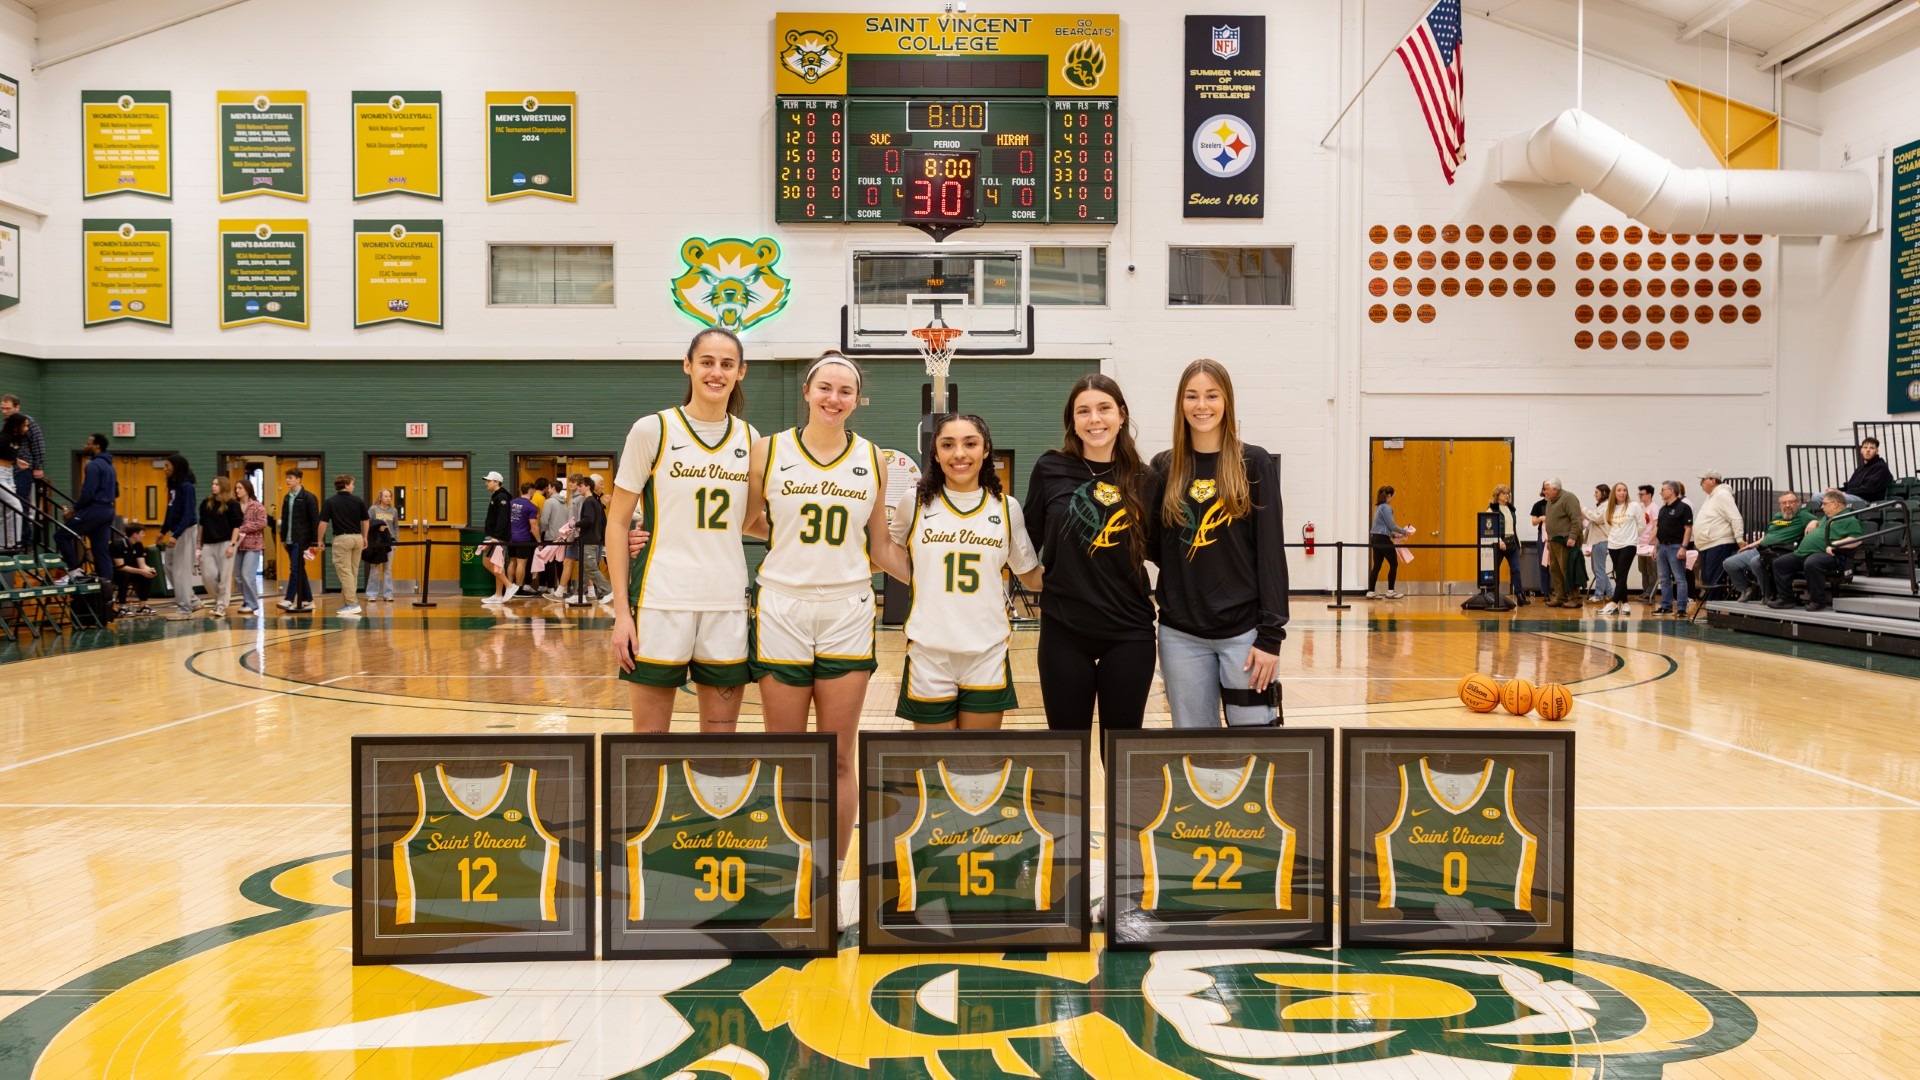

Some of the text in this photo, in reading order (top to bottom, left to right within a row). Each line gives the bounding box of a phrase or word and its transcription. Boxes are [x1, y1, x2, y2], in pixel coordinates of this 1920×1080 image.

[866, 18, 1032, 33] SAINT VINCENT
[1077, 19, 1092, 27] GO
[1055, 28, 1114, 36] BEARCATS!
[898, 36, 1000, 51] COLLEGE
[1216, 40, 1236, 54] NFL
[1233, 69, 1261, 77] HOME
[784, 101, 837, 109] PLYR FLS PTS
[1055, 102, 1109, 110] PLYR FLS PTS
[495, 114, 566, 122] MEN'S WRESTLING
[792, 113, 840, 125] 4 0 0
[928, 104, 983, 128] 8:00
[1064, 114, 1112, 127] 0 0 0
[786, 131, 840, 144] 12 0 0
[870, 134, 891, 145] SVC
[933, 140, 960, 148] PERIOD
[996, 134, 1029, 146] HIRAM
[1064, 132, 1112, 145] 4 0 0
[786, 149, 840, 162] 15 0 0
[885, 150, 898, 173] 0
[1019, 150, 1033, 174] 0
[1054, 150, 1112, 164] 25 0 0
[782, 167, 840, 180] 21 0 0
[925, 158, 971, 178] 8:00
[1055, 168, 1112, 182] 33 0 0
[858, 177, 902, 185] FOULS T.O
[981, 178, 1036, 186] T.O.L. FOULS
[783, 186, 840, 199] 30 0 0
[867, 187, 878, 206] 0
[914, 181, 961, 215] 30
[986, 188, 1032, 206] 4 0
[1054, 186, 1112, 200] 51 0 0
[1188, 193, 1259, 205] Since 1966
[807, 204, 815, 217] 0
[857, 210, 882, 218] SCORE
[1078, 204, 1087, 218] 0
[116, 424, 132, 435] EXIT
[263, 424, 277, 435] EXIT
[410, 424, 424, 435] EXIT
[555, 424, 570, 435] EXIT
[898, 457, 906, 466] G
[669, 461, 750, 483] Saint Vincent
[781, 480, 818, 496] Saint
[821, 480, 868, 501] Vincent
[695, 486, 730, 530] 12
[799, 502, 849, 547] 30
[922, 528, 1003, 549] Saint Vincent
[943, 551, 982, 594] 15
[1466, 684, 1488, 698] Wilson
[928, 827, 1024, 845] Saint Vincent
[1172, 820, 1265, 840] Saint Vincent
[1408, 826, 1504, 845] Saint Vincent
[427, 831, 527, 851] Saint Vincent
[672, 830, 768, 850] Saint Vincent
[957, 851, 995, 896] 15
[1192, 846, 1242, 890] 22
[1443, 851, 1468, 896] 0
[457, 856, 498, 903] 12
[694, 856, 746, 902] 30
